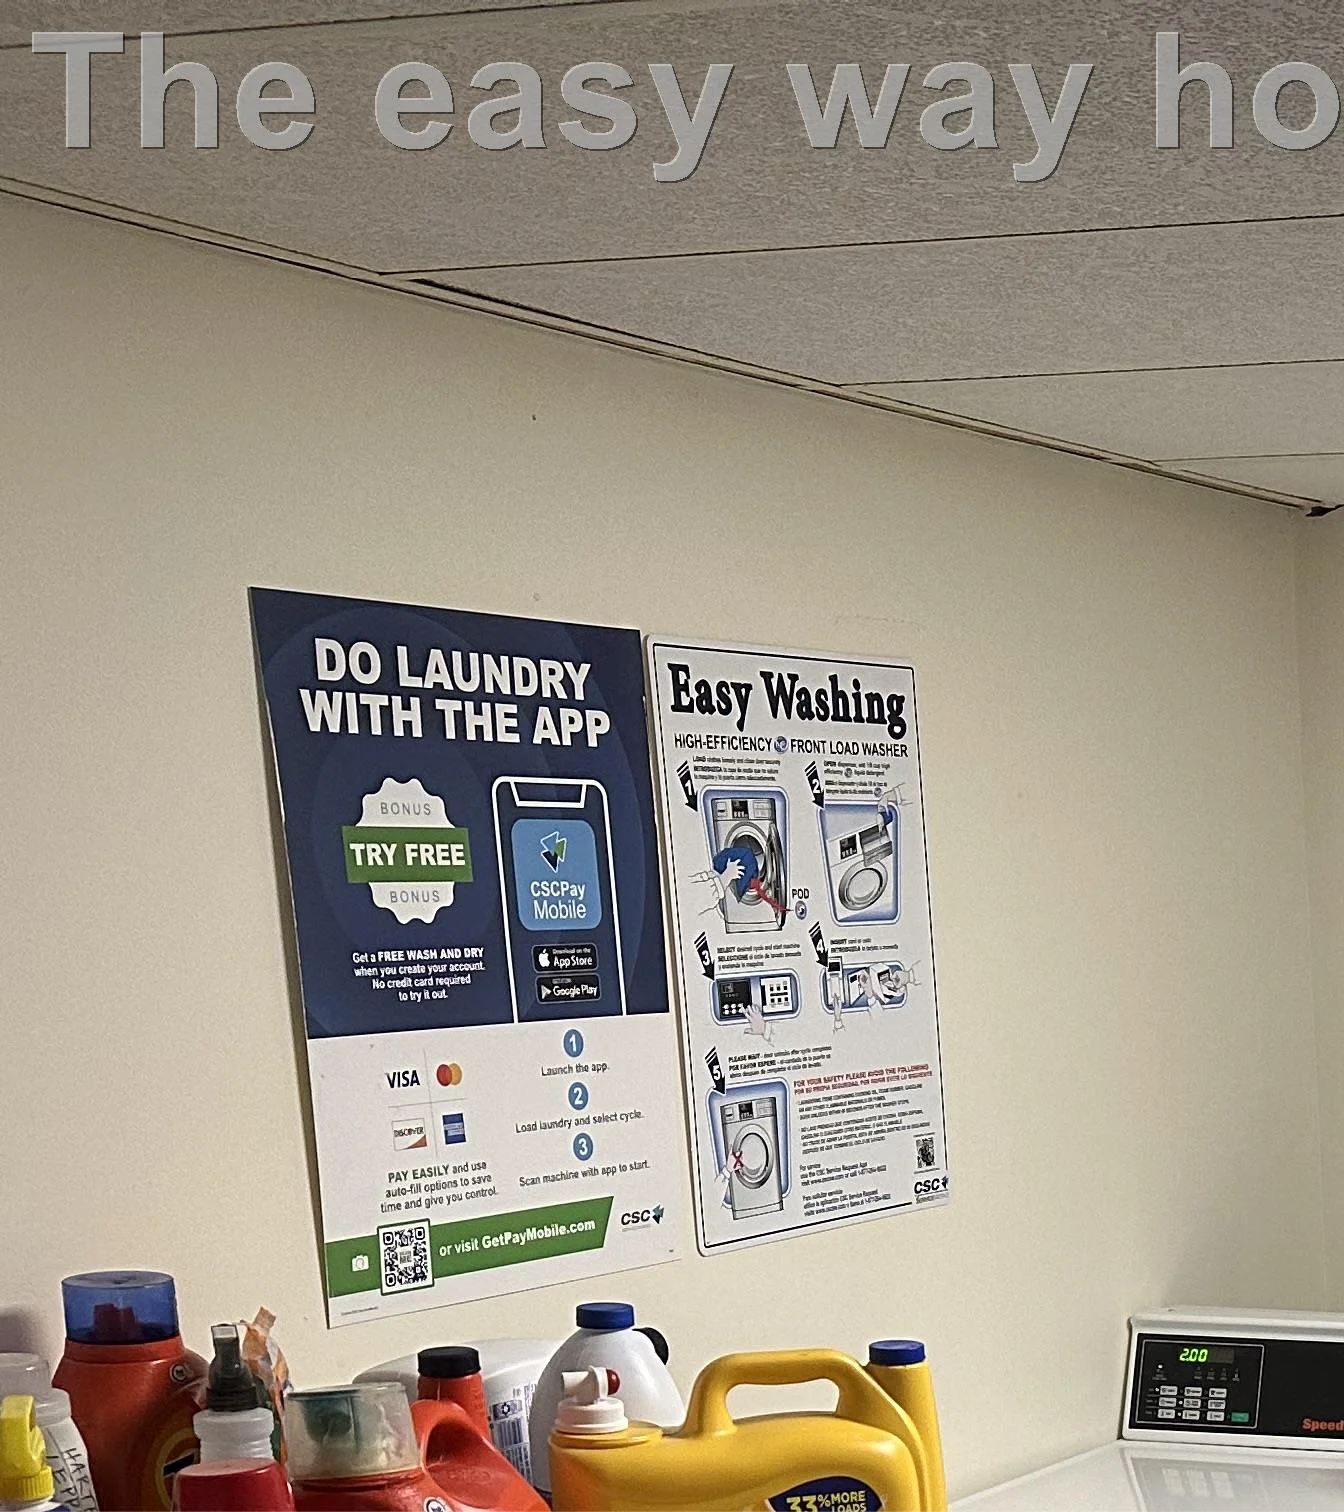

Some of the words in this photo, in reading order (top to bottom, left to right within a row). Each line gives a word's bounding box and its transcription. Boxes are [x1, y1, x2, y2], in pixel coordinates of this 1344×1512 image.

[314, 637, 382, 686] DO
[396, 644, 592, 701] LAUNDRY
[667, 662, 753, 732] Easy
[760, 670, 907, 740] Washing
[299, 688, 423, 739] WITH
[435, 697, 521, 744] THE
[533, 705, 611, 749] APP
[674, 733, 772, 752] HIGH-EFFICIENCY
[790, 738, 827, 754] FRONT
[829, 740, 860, 756] LOAD
[861, 742, 909, 758] WASHER
[811, 779, 821, 793] 2
[380, 801, 431, 817] BONUS
[349, 842, 399, 867] TRY
[405, 842, 466, 867] FREE
[389, 889, 440, 904] BONUS
[530, 880, 586, 901] CSCPay
[791, 888, 810, 899] POD
[533, 900, 587, 920] Mobile
[817, 939, 825, 953] 4
[352, 953, 369, 963] Get
[378, 951, 405, 962] FREE
[406, 949, 438, 961] WASH
[440, 948, 462, 960] AND
[463, 947, 484, 958] DRY
[554, 956, 571, 969] App
[571, 955, 592, 966] Store
[702, 950, 711, 965] 3
[354, 966, 378, 977] when
[380, 967, 396, 977] you
[398, 964, 425, 975] create
[428, 963, 448, 975] your
[372, 979, 385, 989] No
[387, 977, 412, 988] credit
[414, 976, 434, 987] card
[435, 974, 471, 987] required
[398, 991, 408, 1001] to
[410, 990, 422, 1002] try
[553, 985, 580, 998] Google
[580, 984, 598, 996] Play
[568, 1035, 577, 1052] 1
[541, 1064, 573, 1076] Launch
[576, 1063, 589, 1073] the
[592, 1062, 610, 1073] app.
[712, 1065, 721, 1080] 5
[385, 1070, 420, 1089] VISA
[573, 1087, 583, 1105] 2
[515, 1121, 537, 1133] Load
[539, 1118, 572, 1130] laundry
[574, 1115, 591, 1127] and
[592, 1112, 618, 1124] select
[393, 1126, 424, 1138] DISCOVER
[578, 1138, 588, 1155] 3
[388, 1170, 409, 1183] PAY
[412, 1164, 450, 1181] EASILY
[452, 1162, 469, 1174] and
[471, 1161, 487, 1171] use
[519, 1175, 541, 1187] Scan
[542, 1170, 579, 1184] machine
[581, 1166, 599, 1177] with
[601, 1165, 617, 1176] app
[618, 1163, 628, 1172] to
[385, 1183, 422, 1198] auto-fill
[424, 1178, 458, 1193] options
[460, 1177, 469, 1188] to
[471, 1174, 492, 1185] save
[914, 1178, 940, 1194] CSC
[380, 1202, 402, 1213] time
[404, 1199, 422, 1210] and
[424, 1196, 444, 1210] give
[446, 1193, 463, 1206] you
[620, 1208, 651, 1227] CSC
[438, 1244, 452, 1257] or
[454, 1239, 480, 1256] visit
[481, 1218, 596, 1249] GetPayMobile.com
[1179, 1348, 1209, 1362] 2.00
[1302, 1417, 1344, 1433] Speed
[831, 1491, 866, 1505] MORE
